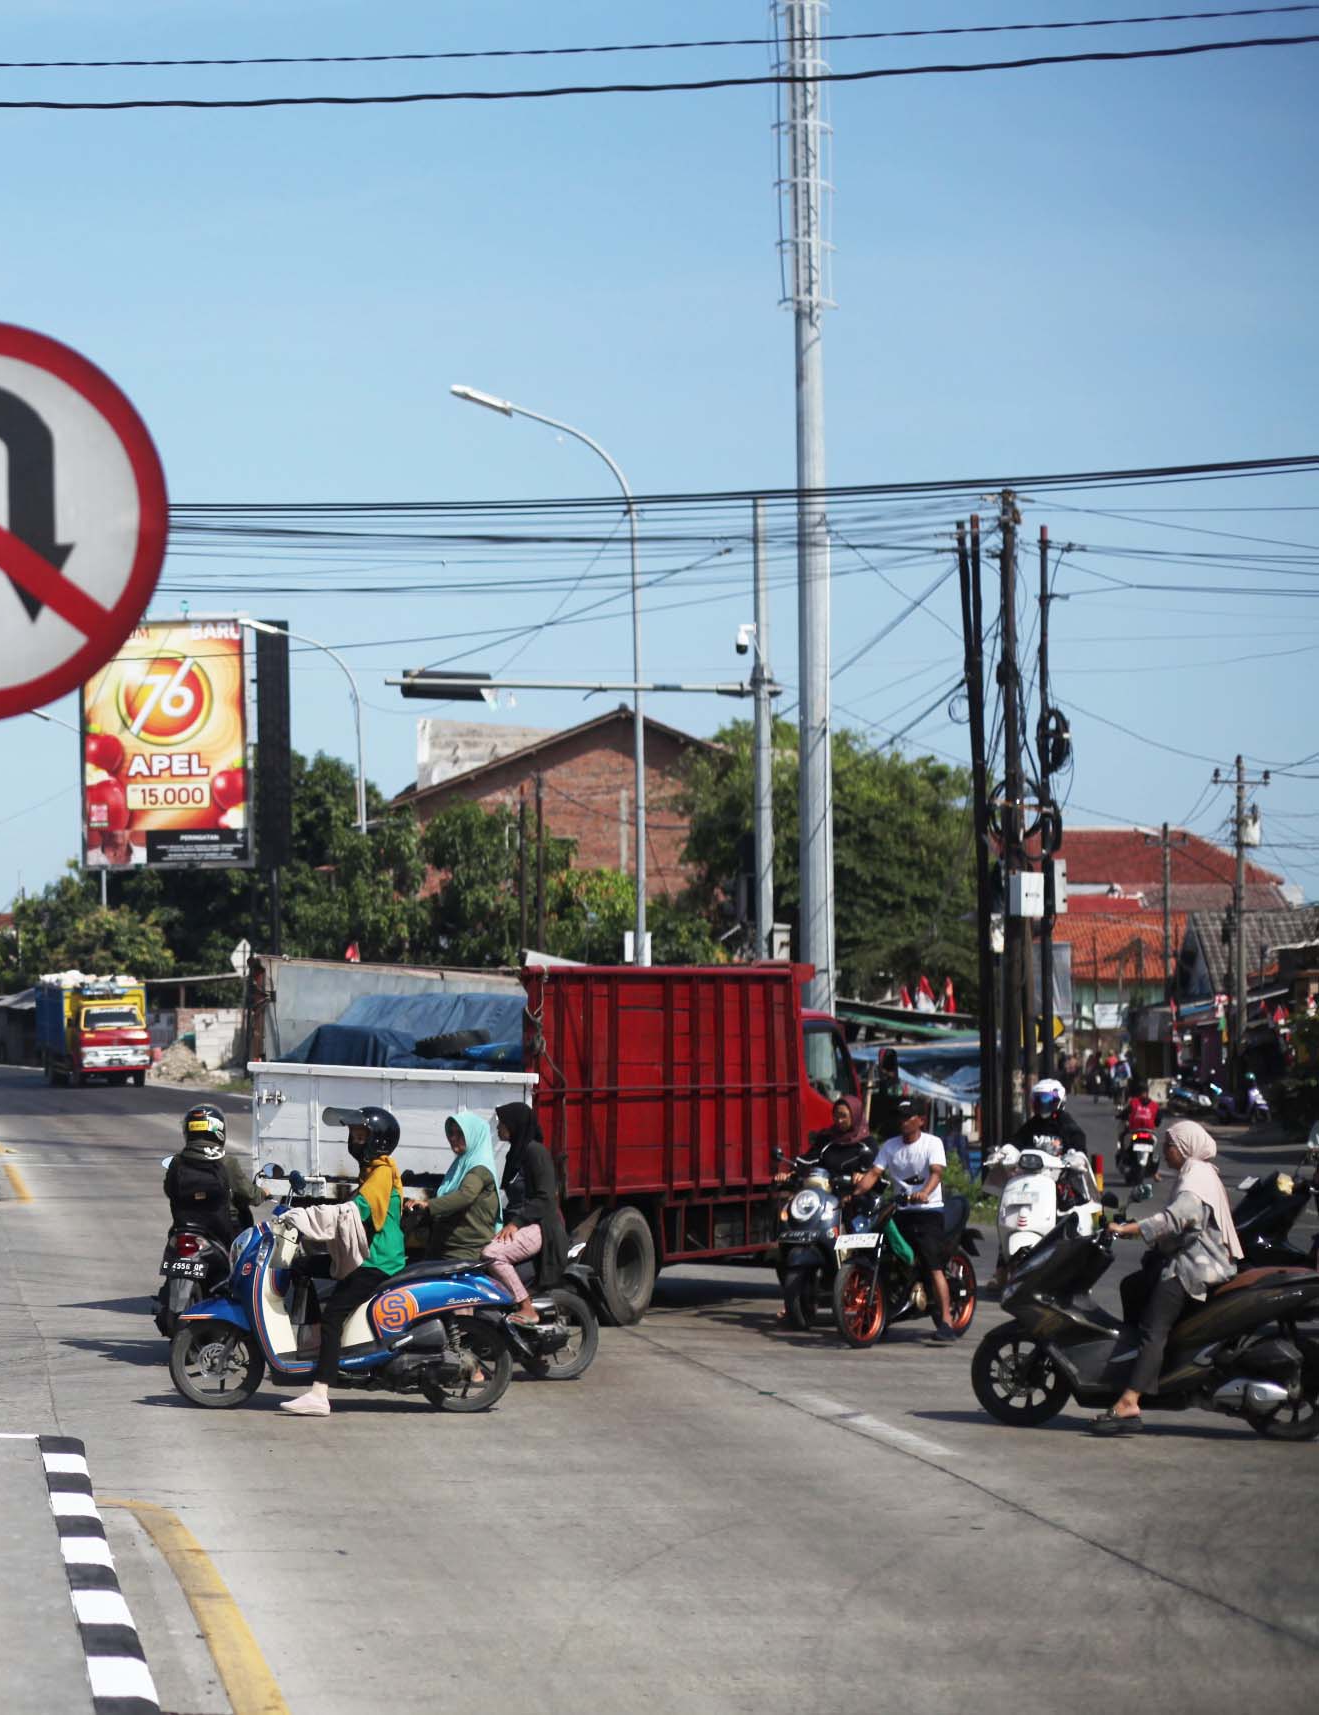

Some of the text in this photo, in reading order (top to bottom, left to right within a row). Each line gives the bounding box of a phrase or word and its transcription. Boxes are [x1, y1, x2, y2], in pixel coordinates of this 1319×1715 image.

[190, 621, 241, 640] BARU
[131, 656, 194, 737] 76
[128, 753, 209, 777] APEL
[141, 787, 204, 806] 15.000
